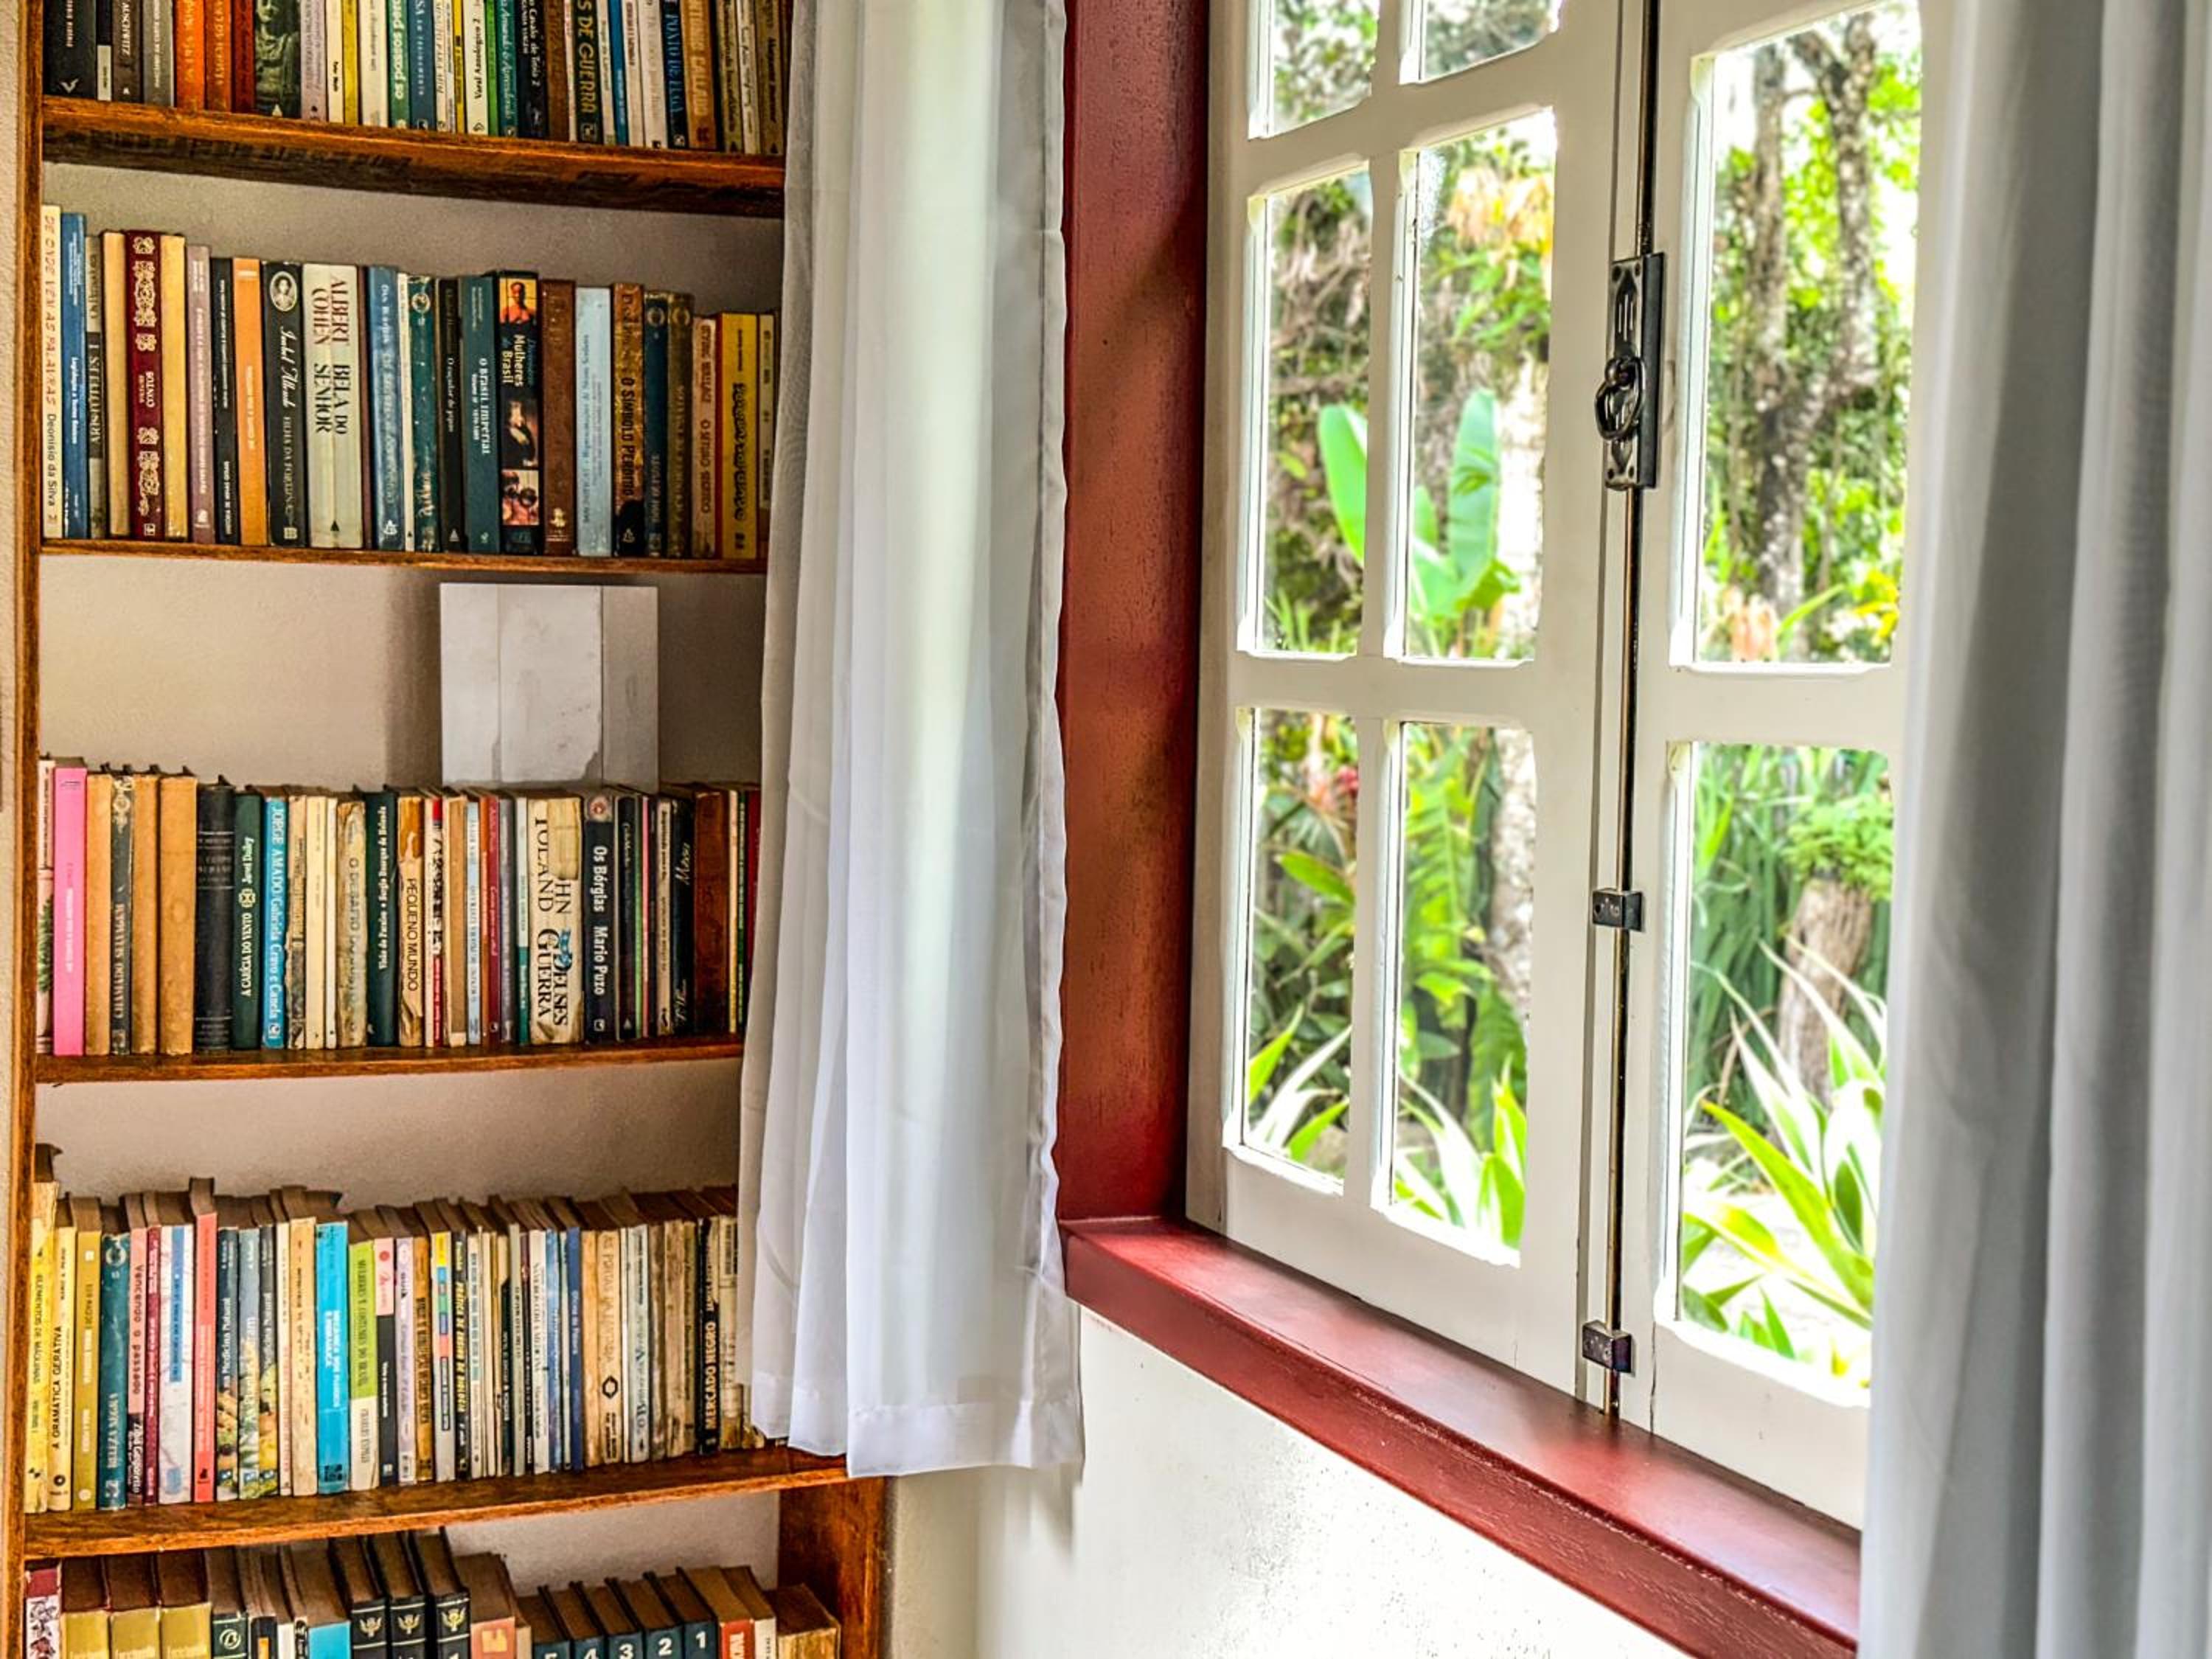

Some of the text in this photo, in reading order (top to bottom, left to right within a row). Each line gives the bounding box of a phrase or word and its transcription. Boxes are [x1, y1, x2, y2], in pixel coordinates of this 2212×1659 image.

[120, 2, 131, 57] AUSCHWITZ
[529, 9, 539, 40] Cavalo
[392, 32, 407, 80] passos
[530, 43, 540, 55] de
[577, 16, 597, 114] DE GUERRA
[394, 83, 406, 100] os
[45, 215, 57, 235] DE
[45, 237, 57, 274] ONDE
[45, 280, 57, 308] VEM
[45, 311, 57, 332] AS
[45, 335, 58, 406] PALAVRAS
[311, 288, 332, 434] COHEN SENHOR
[331, 278, 351, 435] ALBERT BELA DO
[502, 350, 515, 384] Brasil
[512, 334, 526, 387] Mulheres
[145, 371, 156, 408] CONTOS
[621, 377, 635, 387] O
[48, 464, 58, 479] da
[48, 481, 58, 507] Silva
[271, 806, 287, 846] JORGE
[555, 883, 572, 914] HN
[242, 912, 252, 939] VENTO
[405, 877, 419, 991] PEQUENO MUNDO
[591, 846, 609, 995] Os Bórgias Mario Puzo
[114, 903, 126, 1018] CHAMADO SELVAGEM
[242, 940, 251, 954] DO
[536, 928, 560, 1018] GUERRA
[552, 953, 573, 1026] DEUSES
[133, 1264, 146, 1395] Vencendo o passado
[52, 1326, 62, 1376] GERATIVA
[703, 1321, 717, 1430] MERCADO NEGRO
[52, 1442, 60, 1451] A
[620, 1644, 634, 1659] 3
[658, 1638, 673, 1656] 2
[695, 1632, 706, 1649] 1
